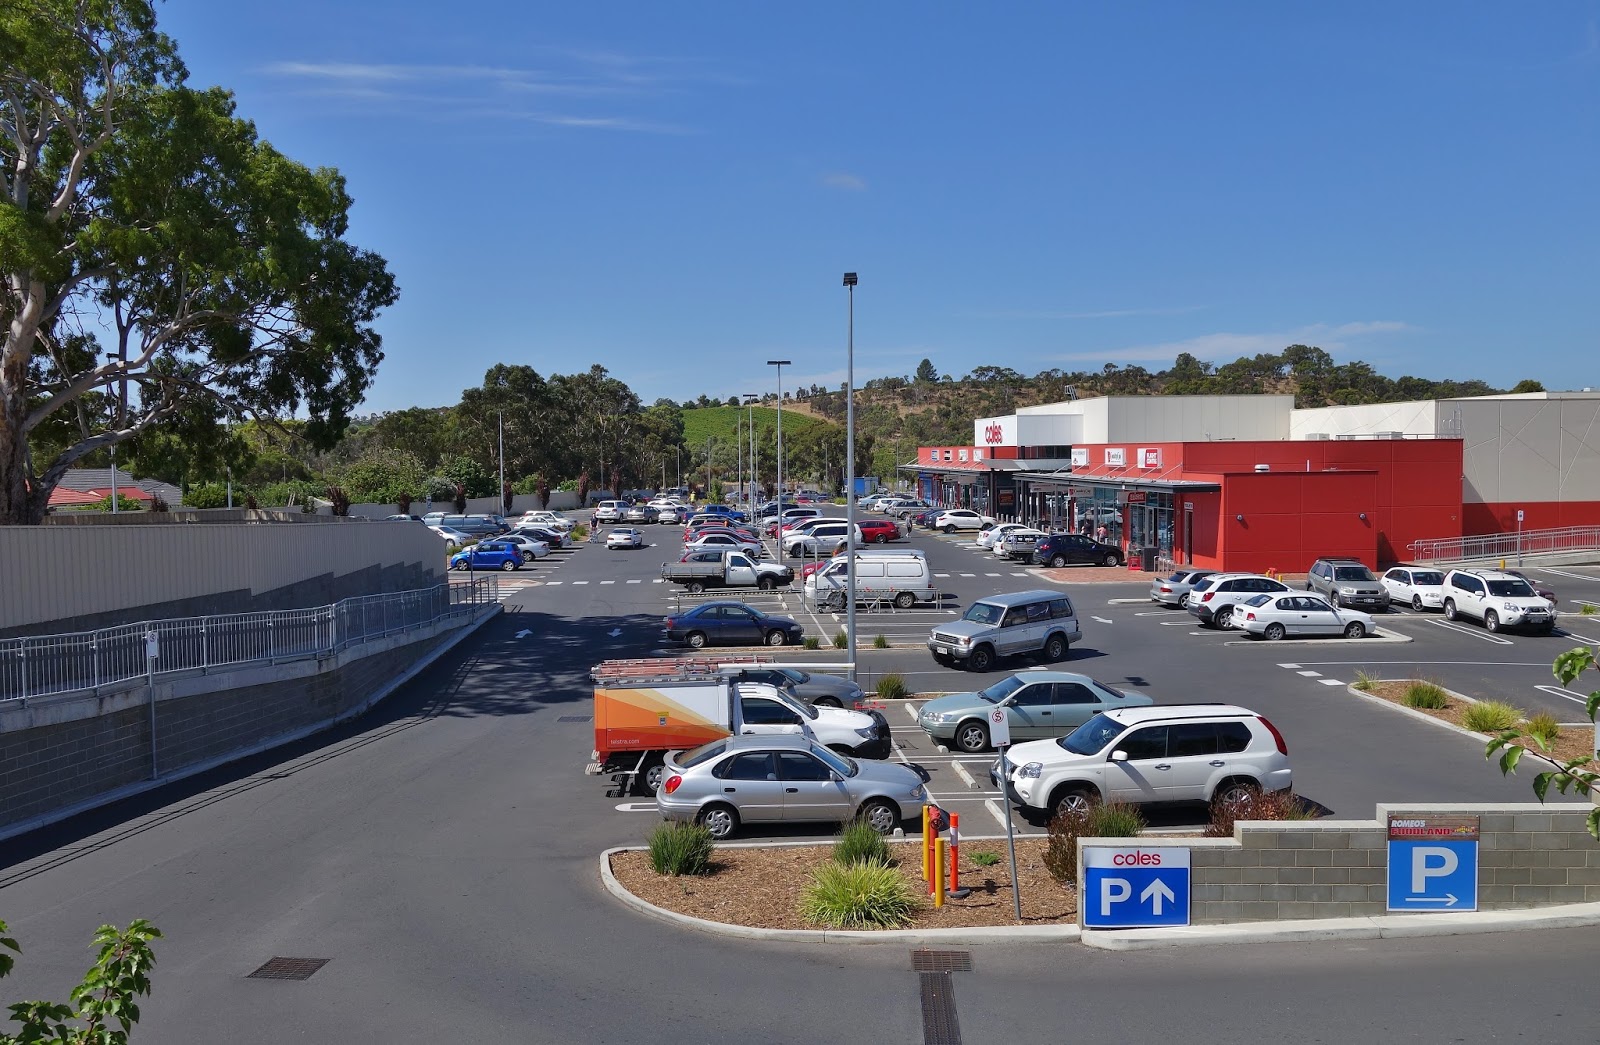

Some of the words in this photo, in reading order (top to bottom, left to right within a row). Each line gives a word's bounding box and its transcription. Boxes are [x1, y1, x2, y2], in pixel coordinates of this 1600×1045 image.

[1391, 820, 1426, 828] ROMEO'S
[1391, 828, 1450, 836] FOODLAND
[1113, 850, 1161, 865] coles
[1412, 846, 1459, 893] P
[1101, 878, 1132, 916] P
